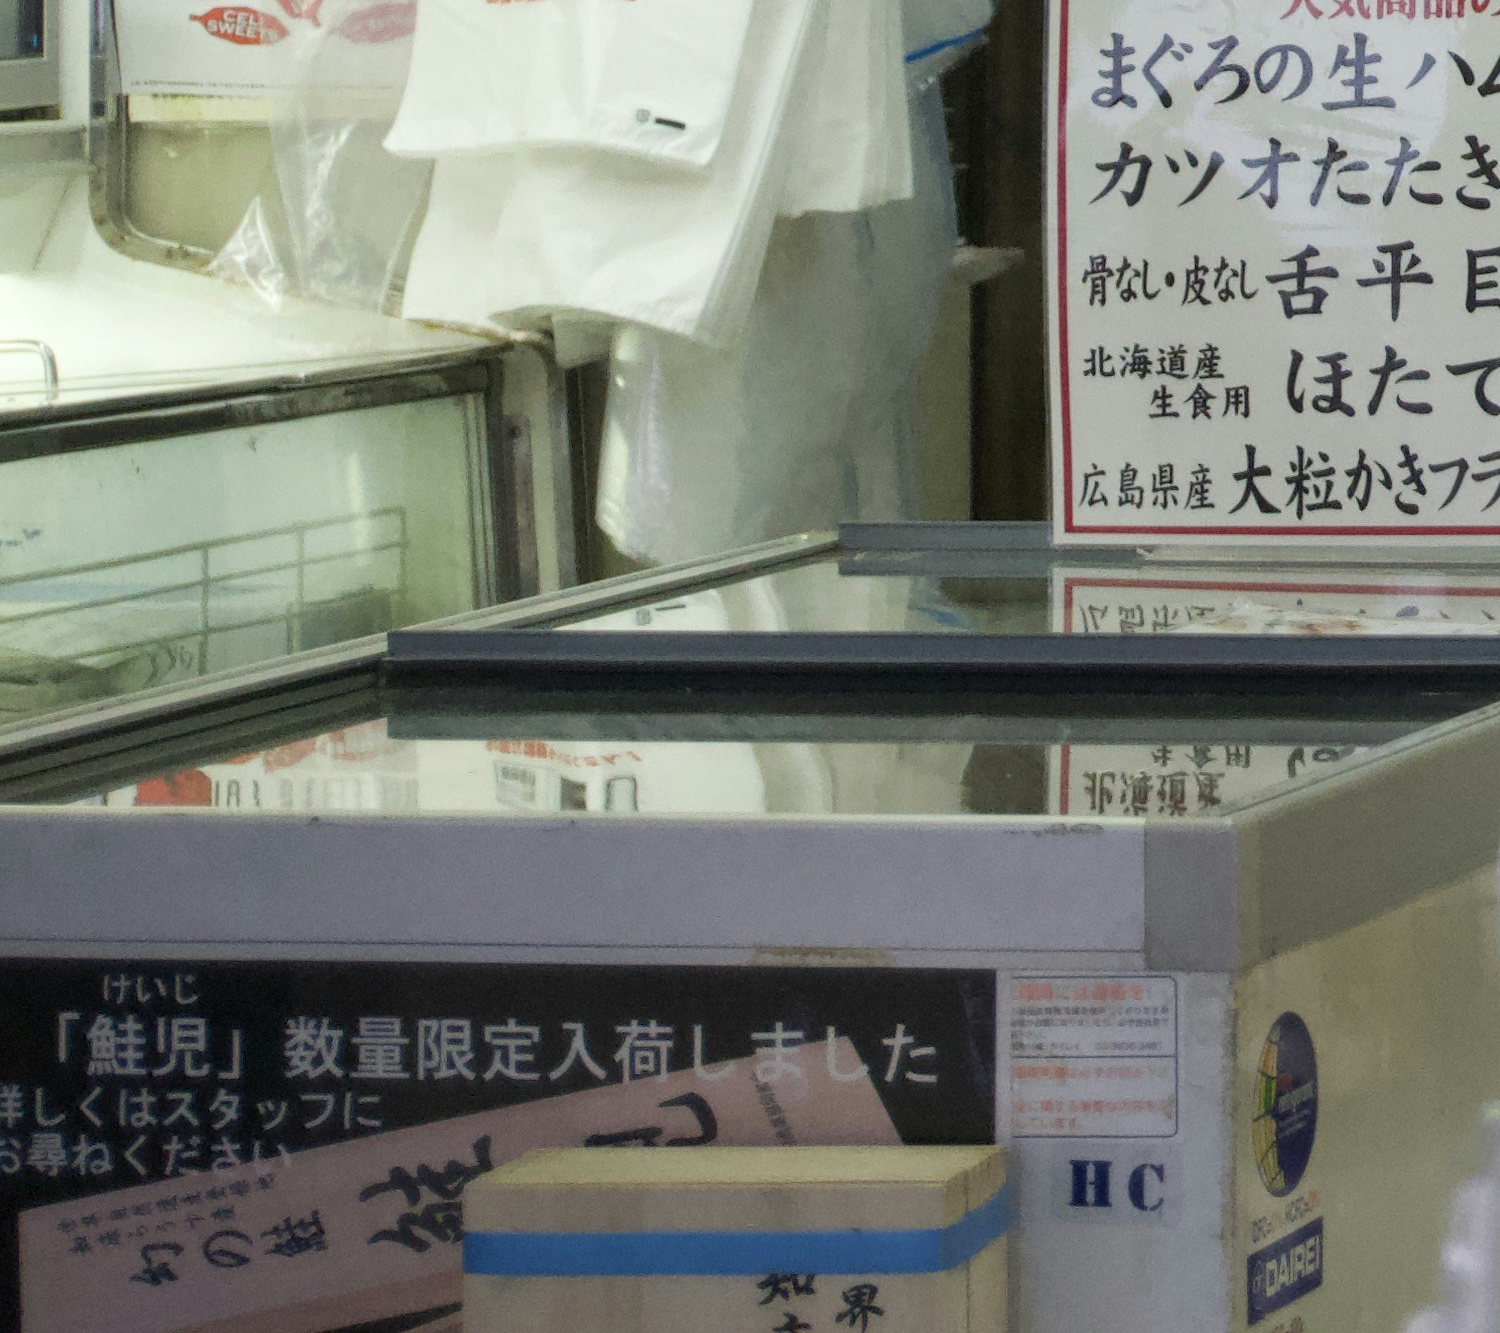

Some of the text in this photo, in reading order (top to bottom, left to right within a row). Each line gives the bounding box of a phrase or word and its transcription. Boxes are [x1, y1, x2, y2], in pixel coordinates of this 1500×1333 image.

[1080, 253, 1259, 309] 骨なし・皮なし
[1082, 342, 1226, 381] 北海道産
[1147, 382, 1251, 422] 生食用
[1078, 461, 1216, 512] 広島県産
[102, 972, 199, 1006] けいじ
[57, 1009, 940, 1086] 「鮭児」数量限定入荷しました
[1069, 1159, 1166, 1212] HC
[130, 1207, 327, 1287] 幻の鮭
[1265, 1235, 1321, 1298] DAIREI
